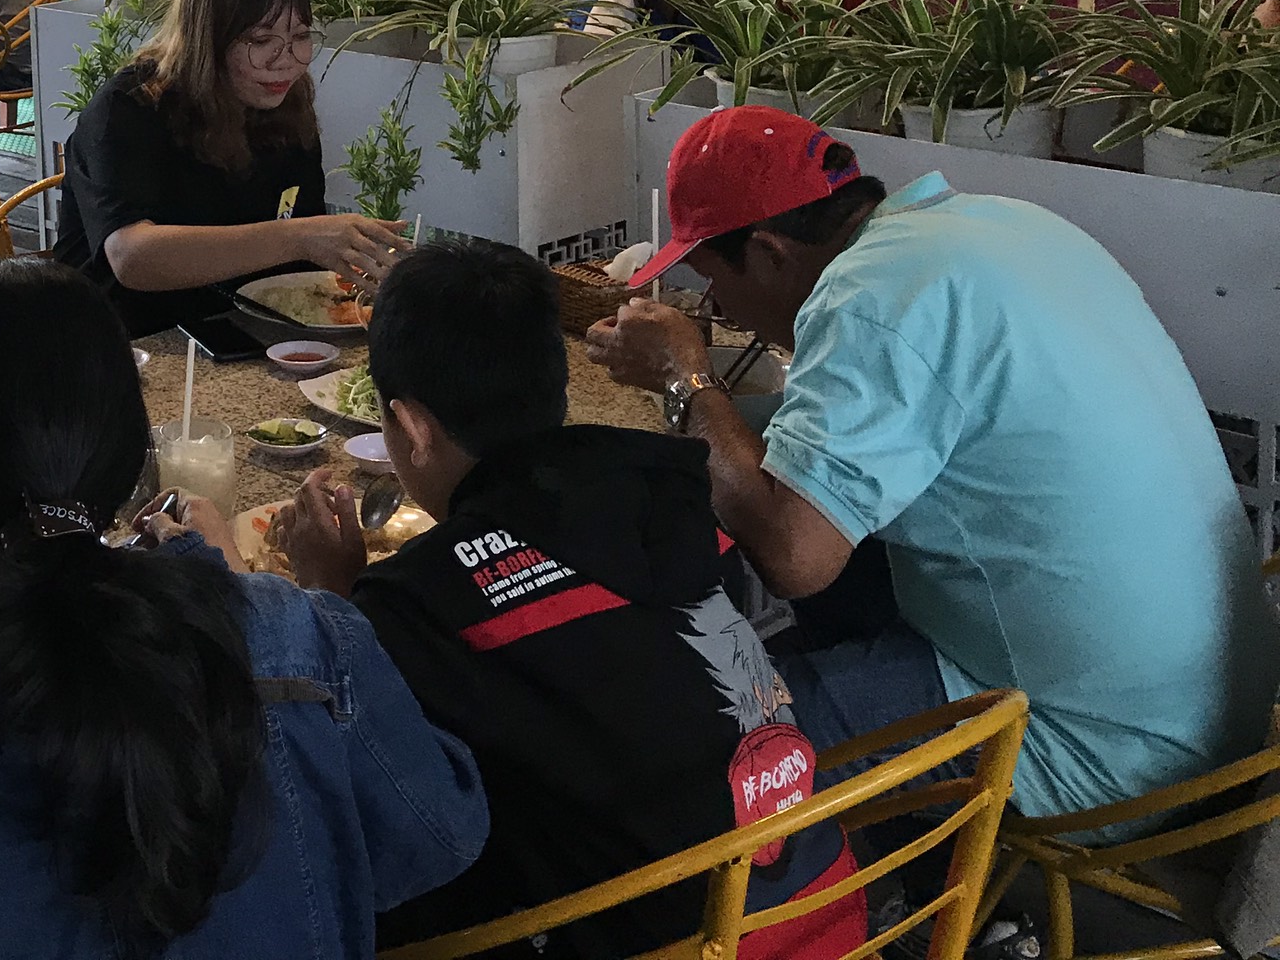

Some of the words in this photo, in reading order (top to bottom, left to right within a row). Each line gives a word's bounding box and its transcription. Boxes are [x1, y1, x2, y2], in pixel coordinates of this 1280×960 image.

[453, 529, 528, 568] Craz
[487, 579, 511, 594] came
[510, 568, 532, 584] from
[532, 559, 558, 575] spring
[490, 592, 507, 608] you
[506, 584, 526, 599] said
[524, 581, 536, 592] in
[534, 570, 565, 588] autumn
